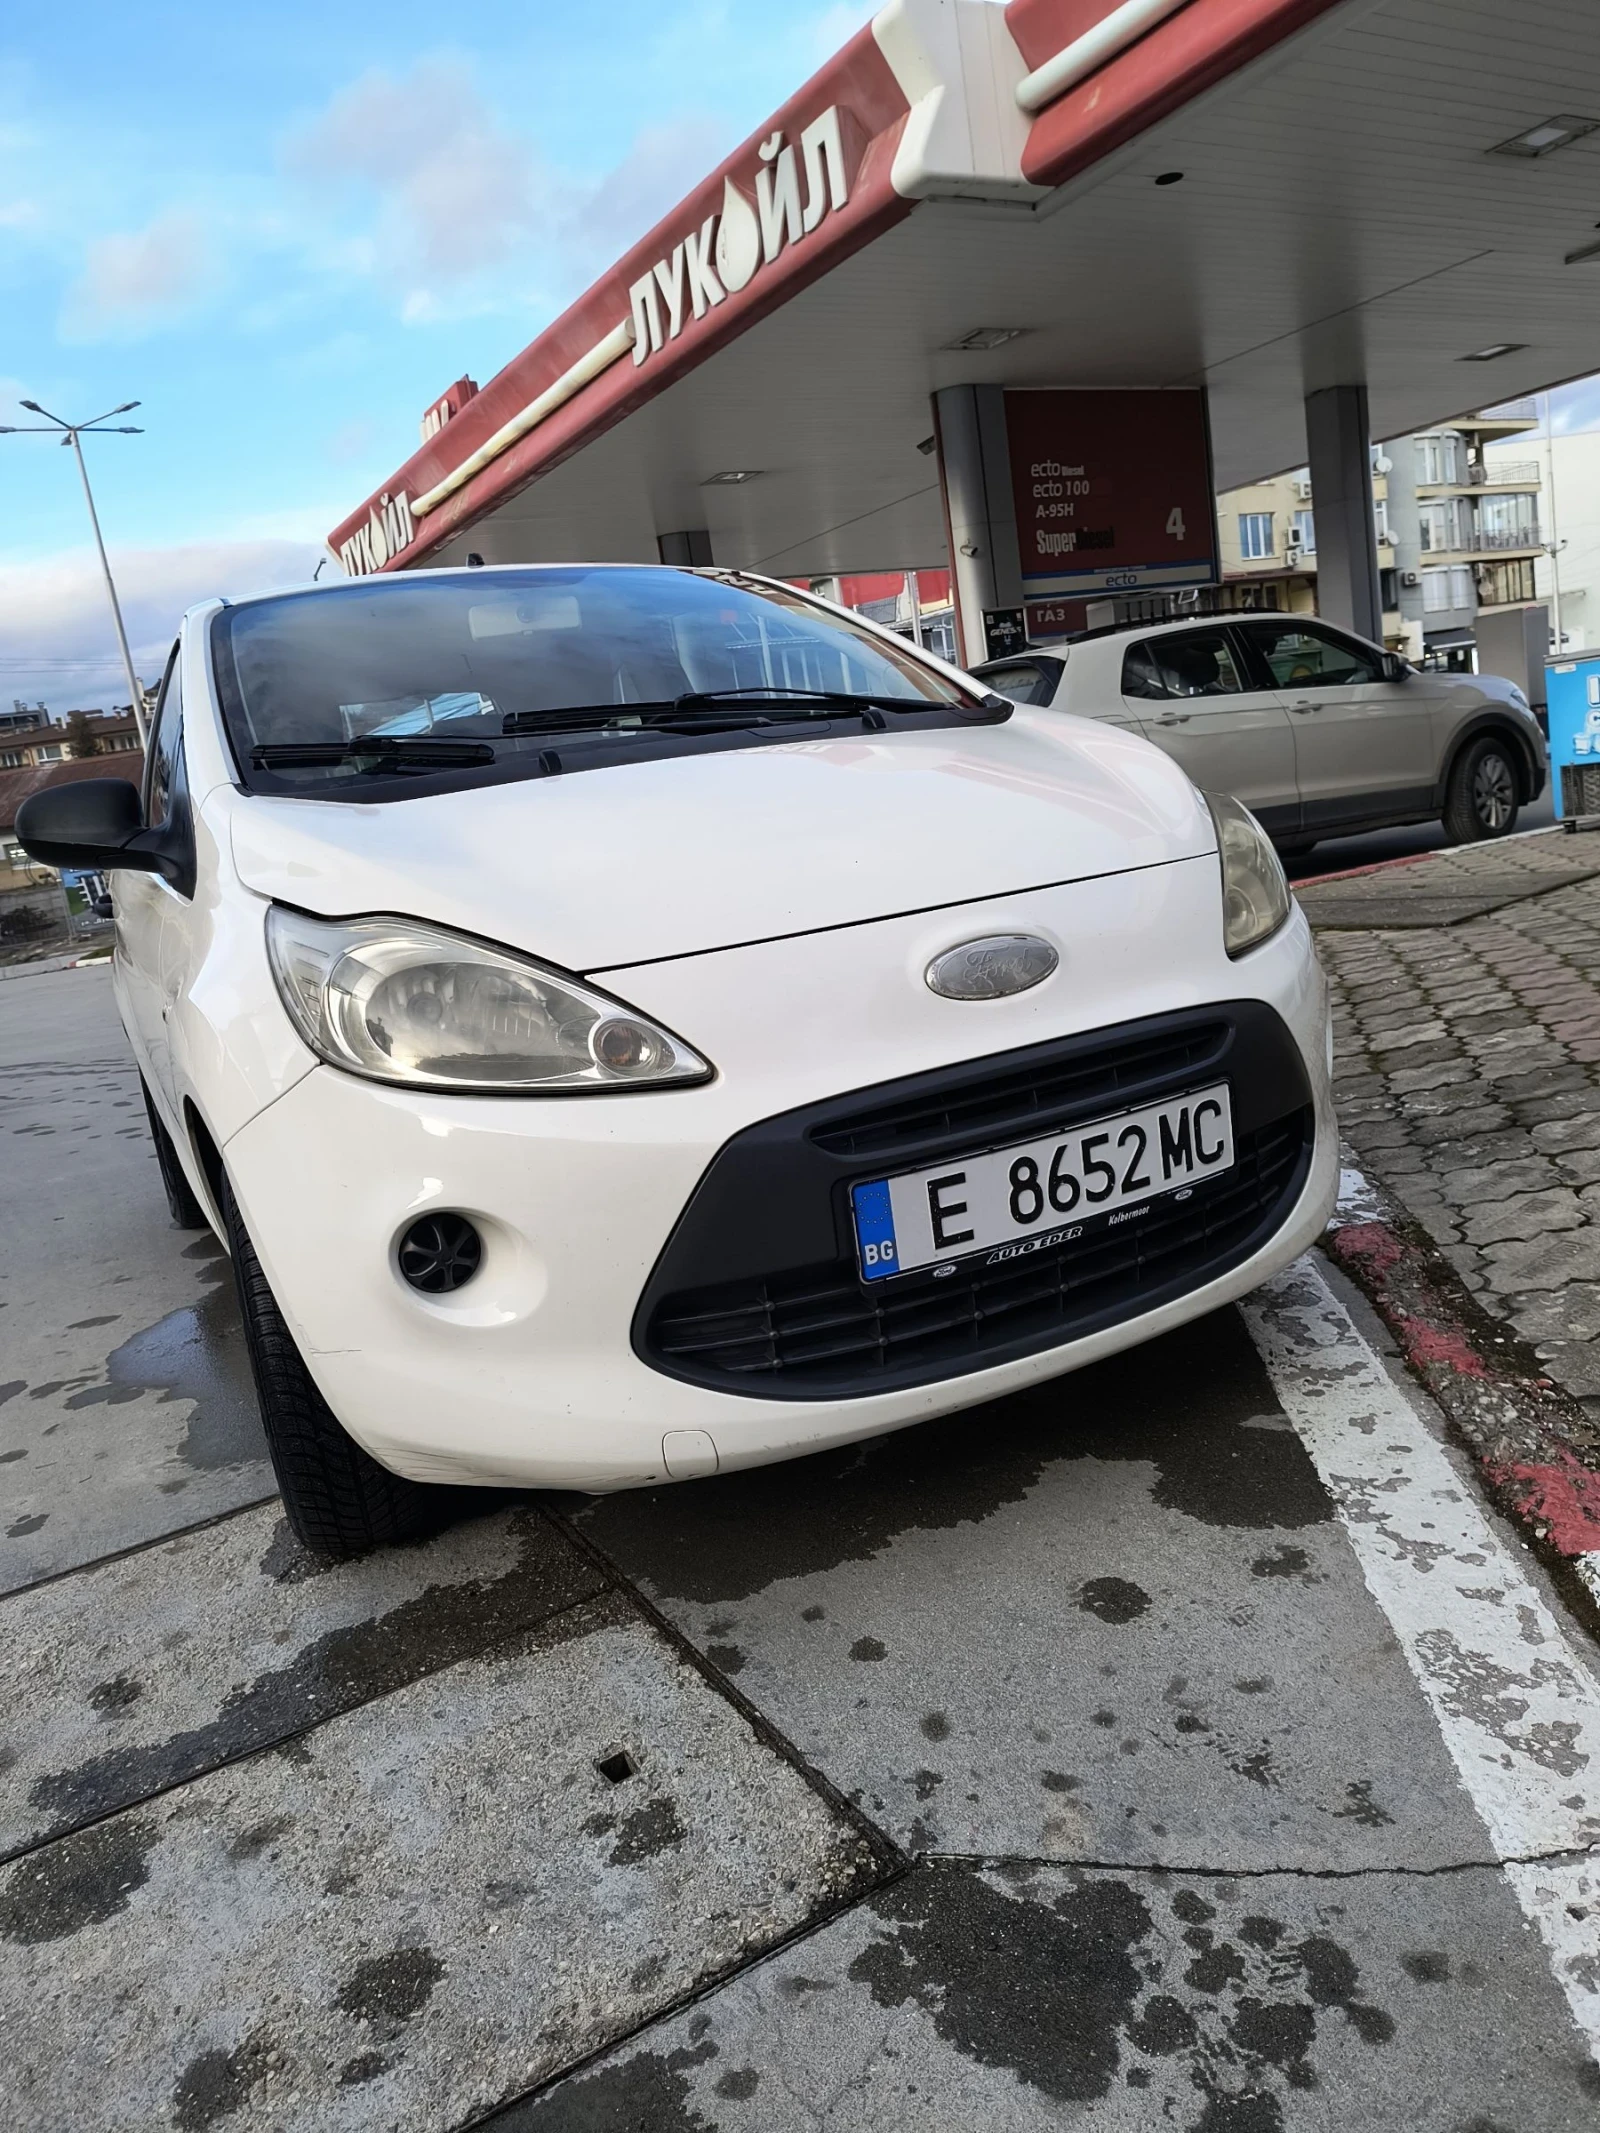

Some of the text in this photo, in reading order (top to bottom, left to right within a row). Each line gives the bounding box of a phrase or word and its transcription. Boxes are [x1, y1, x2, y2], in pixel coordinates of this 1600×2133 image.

[629, 105, 848, 367] ЛУКОЙЛ
[1031, 460, 1060, 477] ecto
[1033, 480, 1090, 497] ecto 100
[1165, 507, 1186, 541] 4
[1106, 573, 1137, 587] ecto
[1036, 608, 1066, 622] ГАЗ
[926, 1099, 1224, 1250] E 8652 MC
[1108, 1206, 1150, 1226] Kolbermoor
[865, 1240, 893, 1265] BG
[986, 1226, 1083, 1264] AUTO EDER
